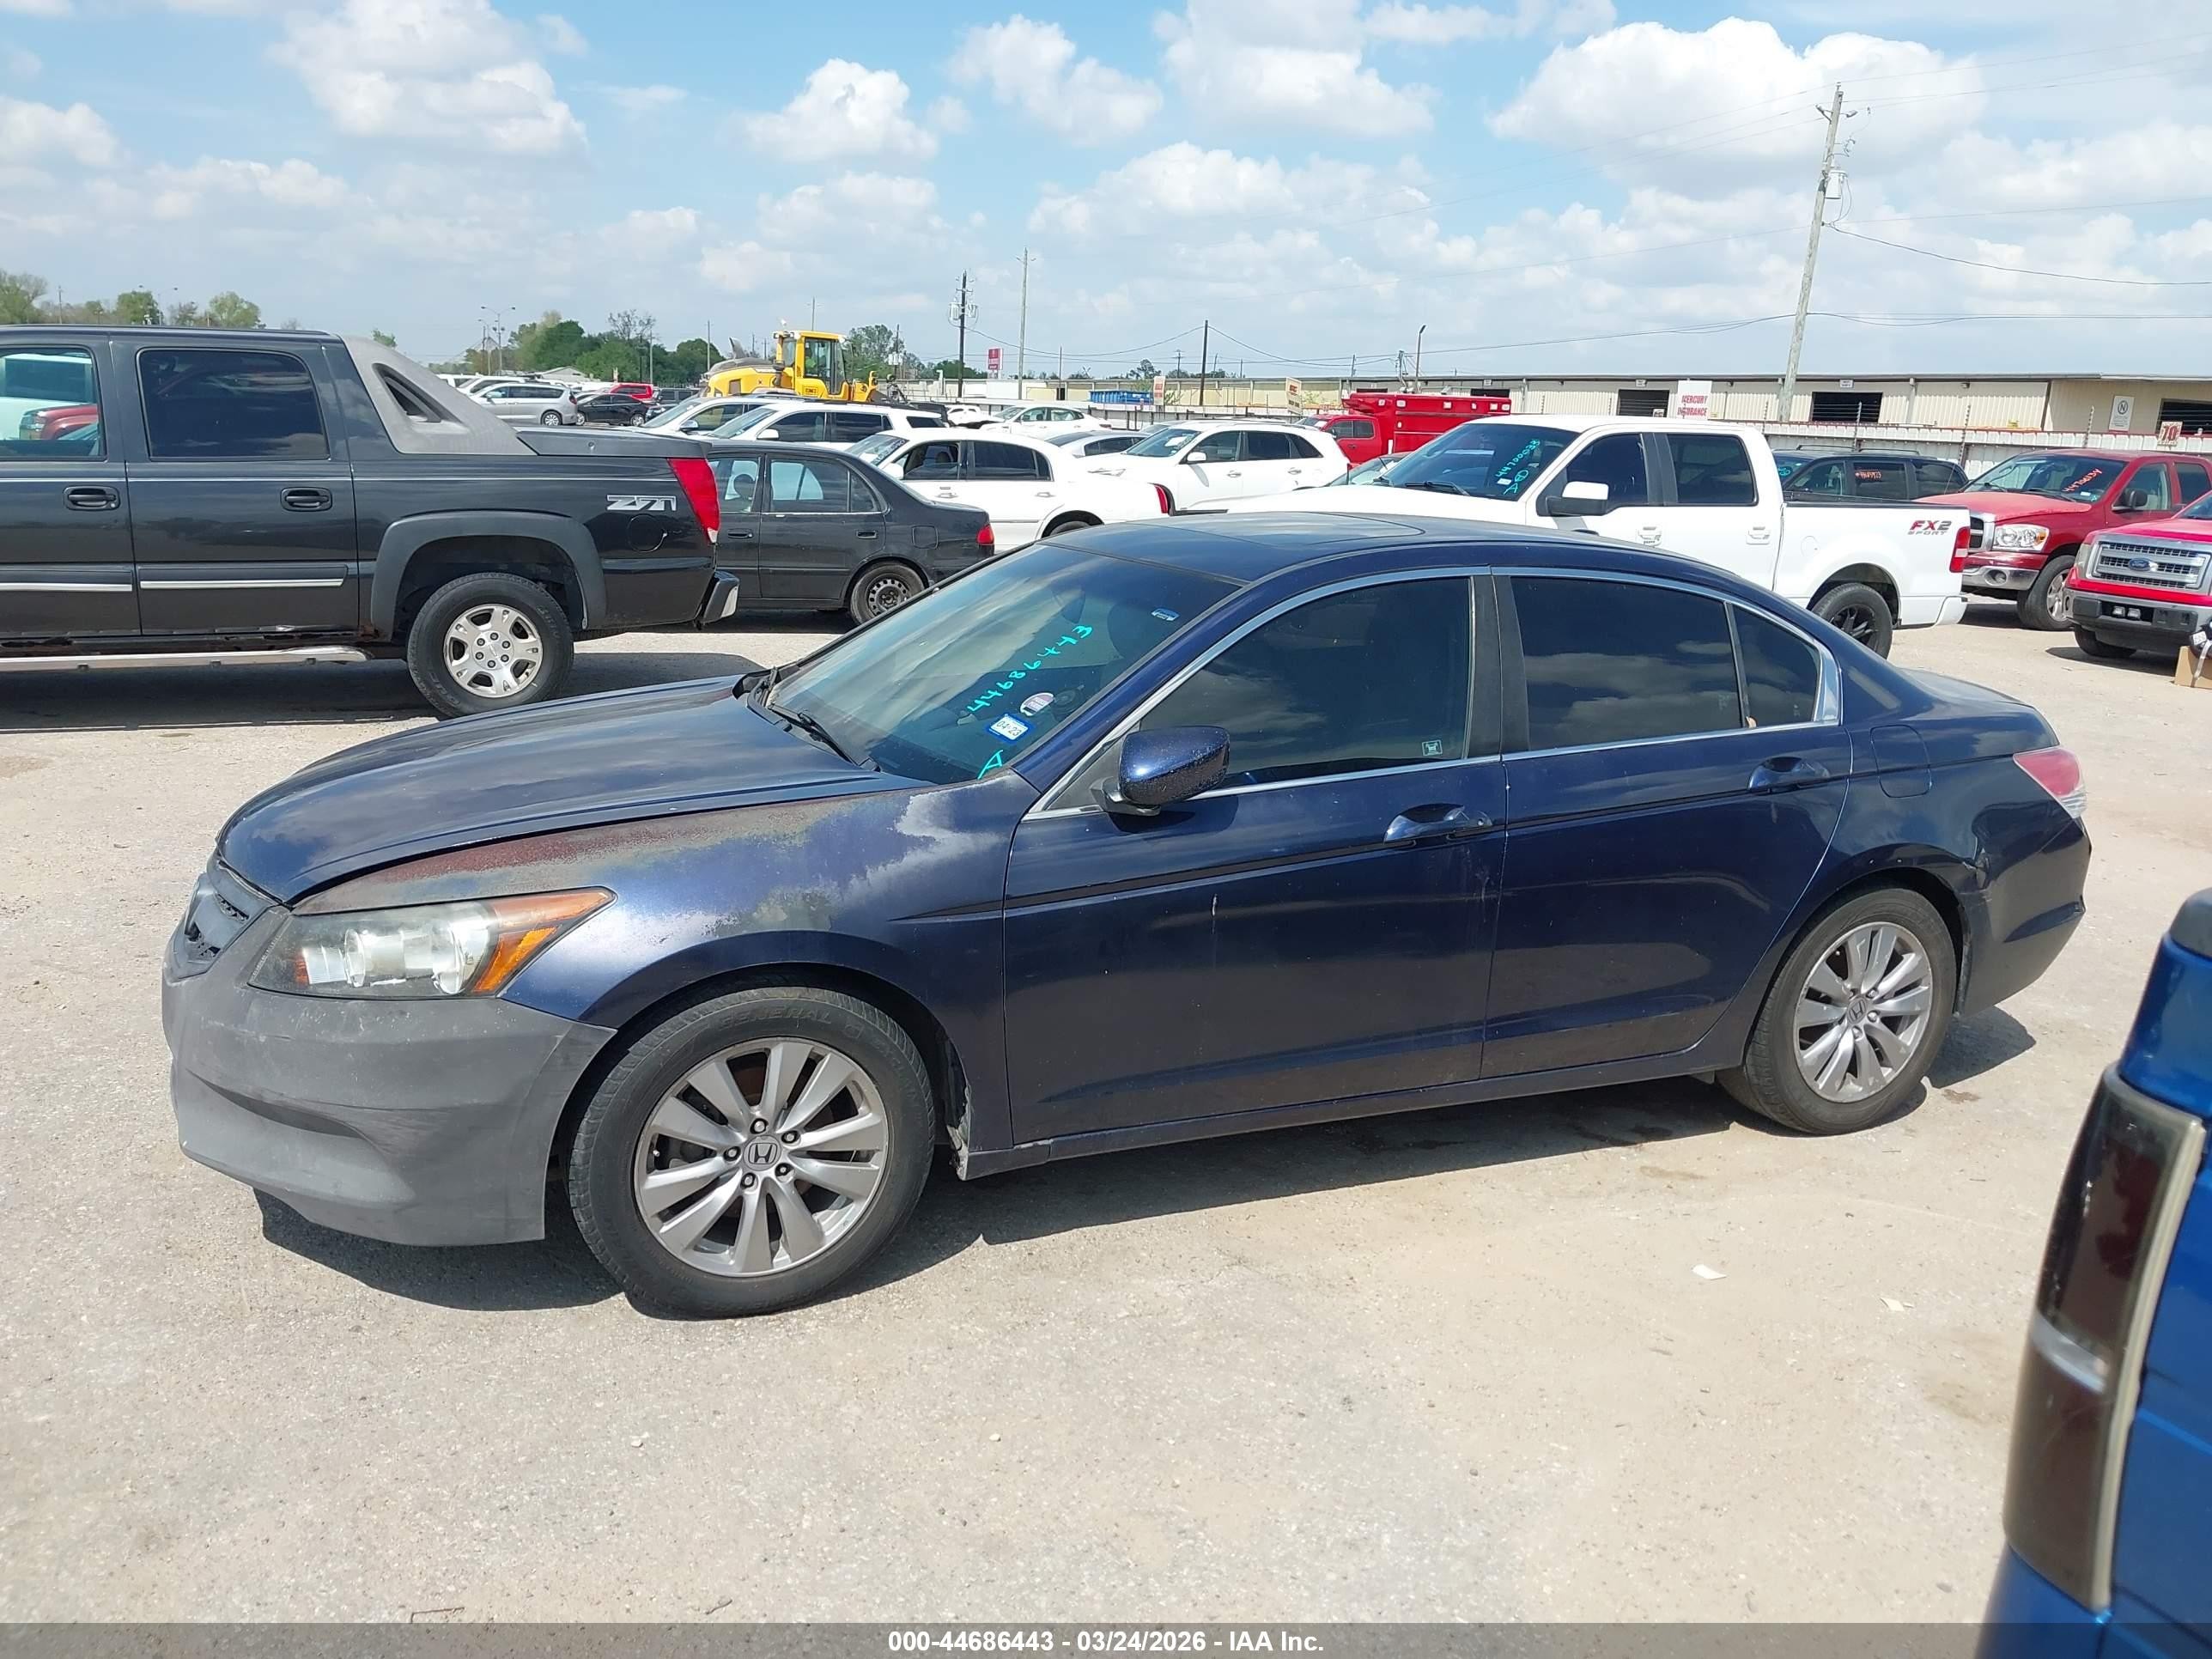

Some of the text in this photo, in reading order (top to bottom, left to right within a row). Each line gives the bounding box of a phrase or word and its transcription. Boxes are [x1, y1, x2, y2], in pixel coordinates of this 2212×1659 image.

[1681, 395, 1708, 404] MERCURY
[606, 495, 677, 511] Z71
[1909, 520, 1953, 531] FX2
[967, 625, 1092, 711] 44686443
